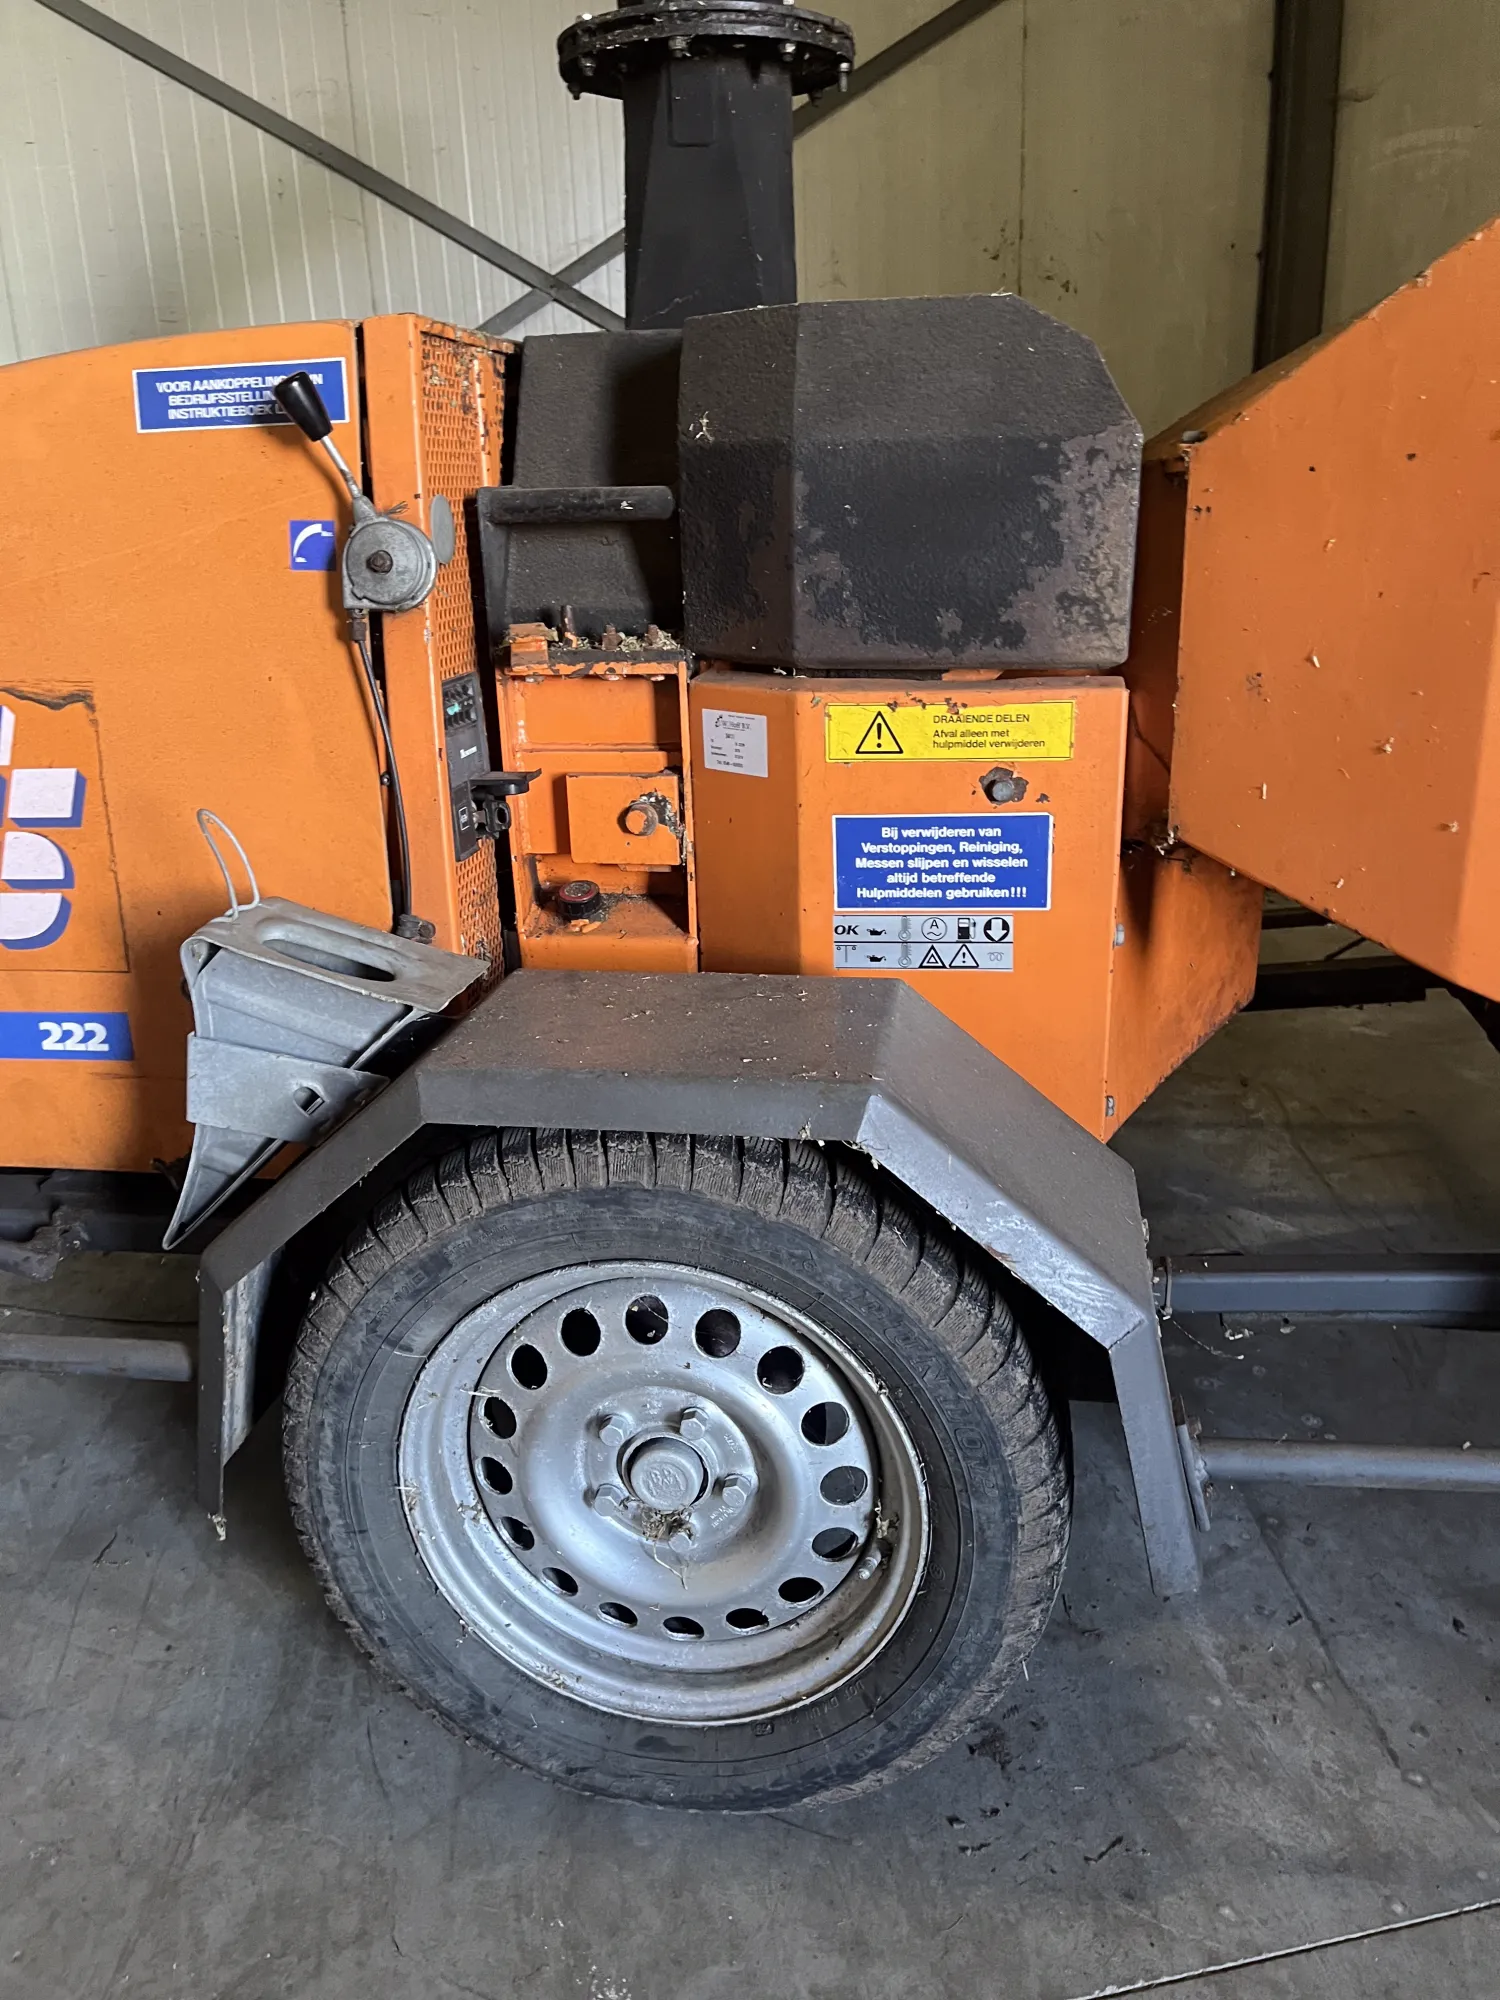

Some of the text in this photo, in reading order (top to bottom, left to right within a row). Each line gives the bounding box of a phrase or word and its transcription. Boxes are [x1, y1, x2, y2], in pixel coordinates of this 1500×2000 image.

[155, 380, 192, 393] VOOR
[168, 390, 277, 407] BEDRIJFSSTELLIN
[167, 404, 274, 420] INSTRUKTIEBOEK
[933, 713, 1030, 724] DRAAIENDE DELEN
[933, 729, 1010, 738] Afval alleen met
[932, 739, 1046, 750] hulpmiddel verwijderen
[881, 826, 1002, 840] Bij verwijderen van
[861, 841, 1023, 855] Verstoppingen, Reiniging,
[855, 857, 1028, 870] Messen slijpen en wisselen
[887, 872, 996, 885] altijd betreffende
[856, 887, 943, 900] Hulpmiddelen
[834, 924, 860, 936] OK
[38, 1021, 110, 1051] 222
